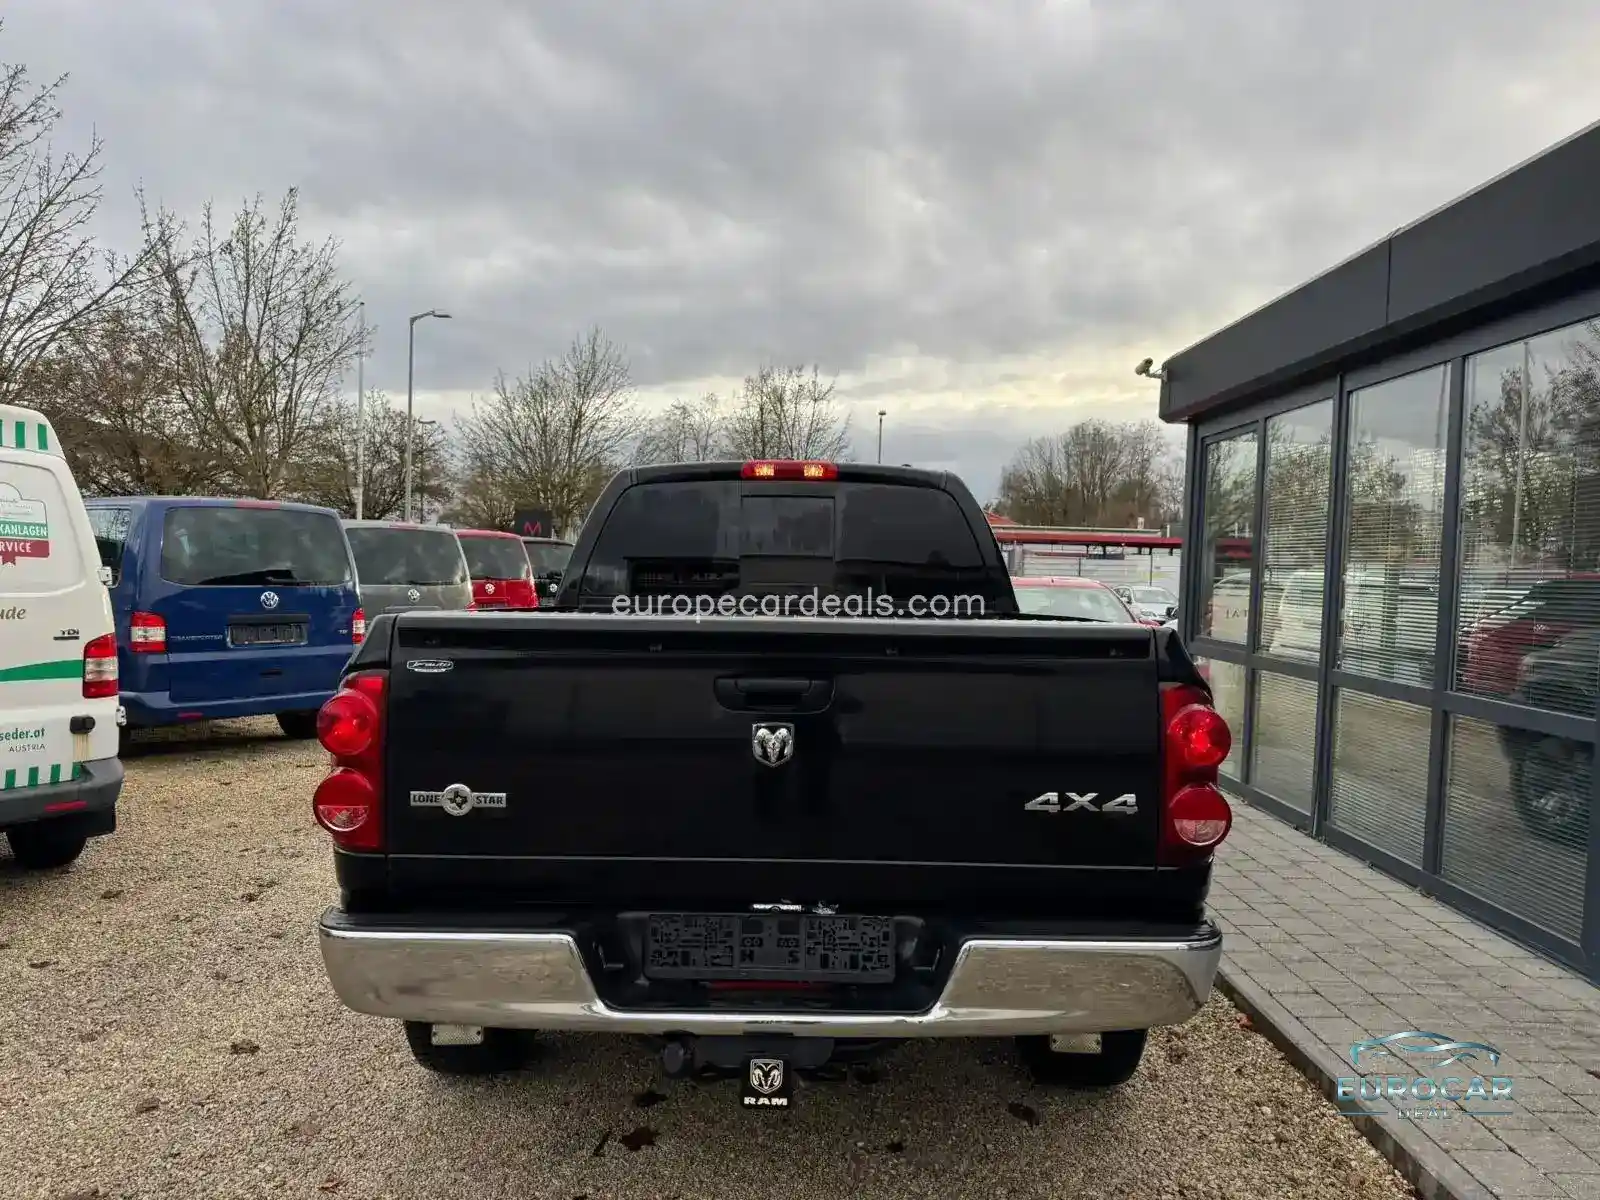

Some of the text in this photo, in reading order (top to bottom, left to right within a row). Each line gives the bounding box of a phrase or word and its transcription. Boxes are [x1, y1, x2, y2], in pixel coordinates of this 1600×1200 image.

[0, 727, 46, 741] seder.at
[9, 743, 46, 752] AUSTRIA
[412, 794, 503, 805] LONE STAR
[1024, 792, 1139, 815] 4X4
[743, 1096, 788, 1106] RAM
